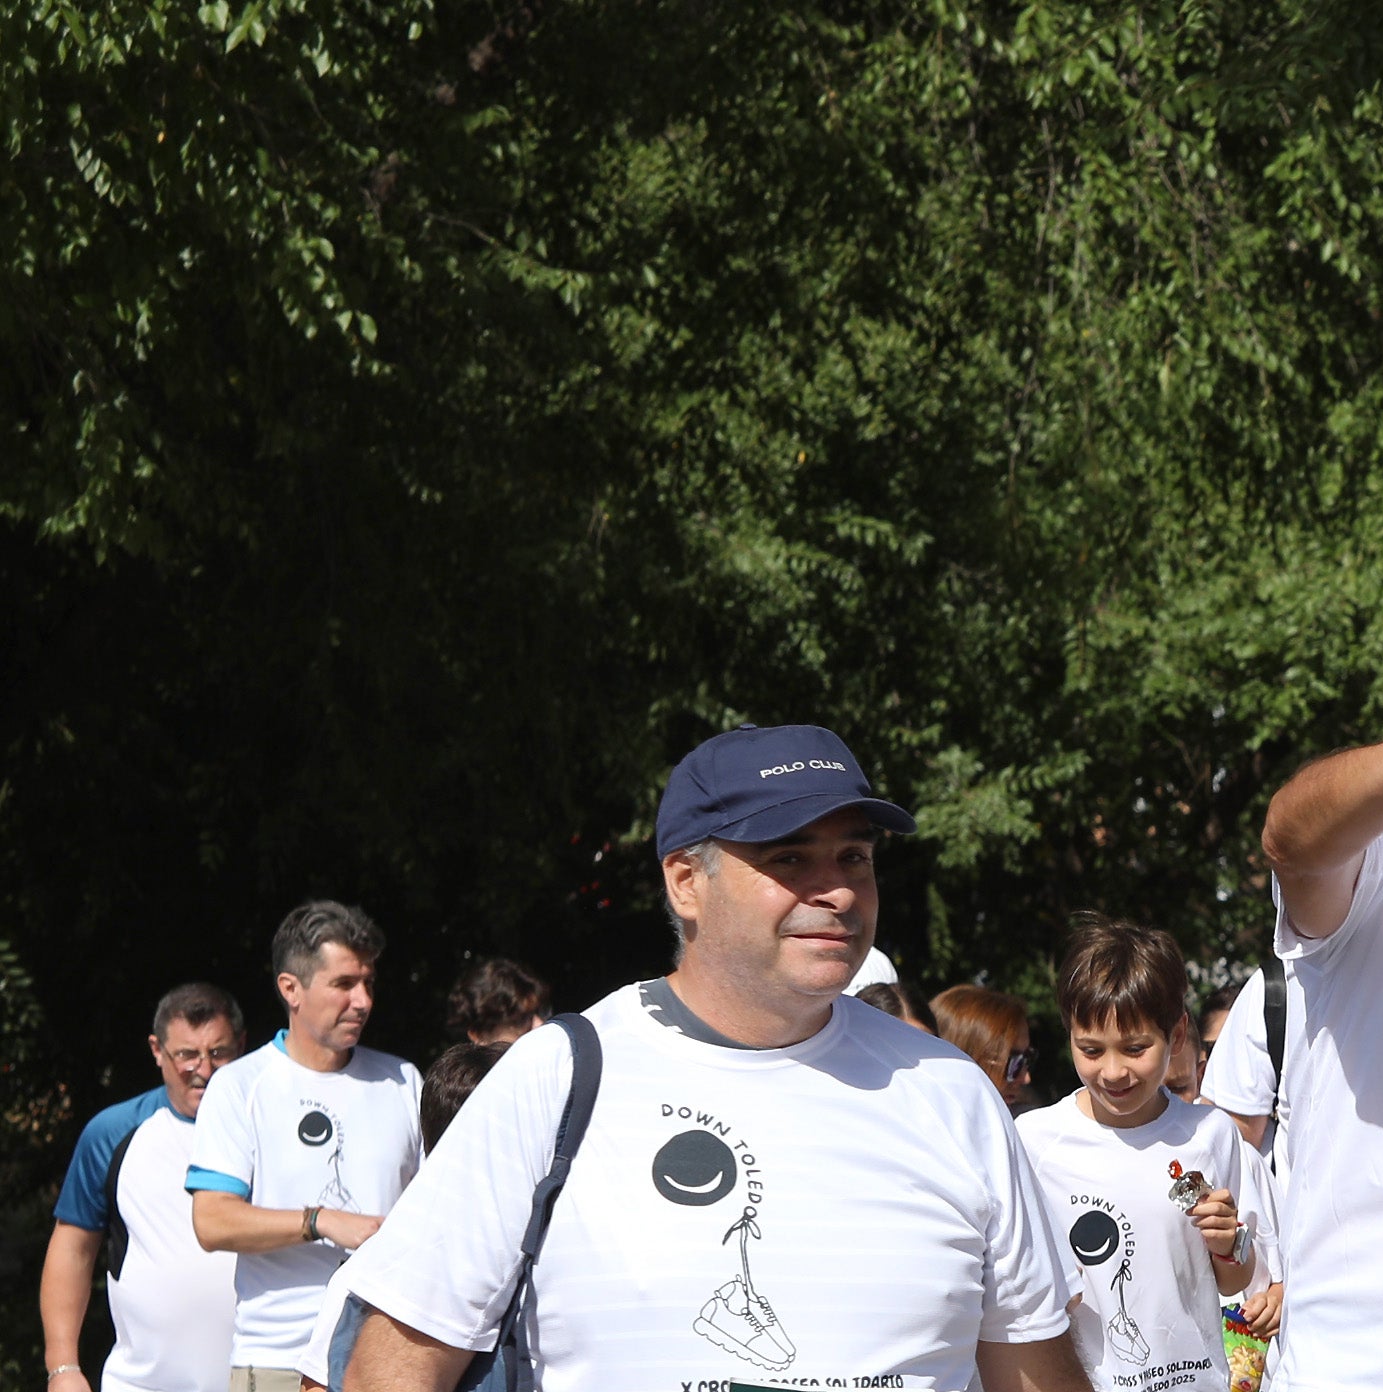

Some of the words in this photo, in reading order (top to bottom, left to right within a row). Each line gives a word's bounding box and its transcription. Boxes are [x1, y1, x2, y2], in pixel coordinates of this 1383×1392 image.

[760, 762, 805, 778] POLO
[809, 760, 847, 771] CLUB
[661, 1103, 731, 1136] DOWN
[734, 1139, 763, 1219] TOLEDO
[1070, 1195, 1115, 1213] DOWN
[1117, 1212, 1135, 1268] TOLEDO
[1171, 1373, 1196, 1387] 2025
